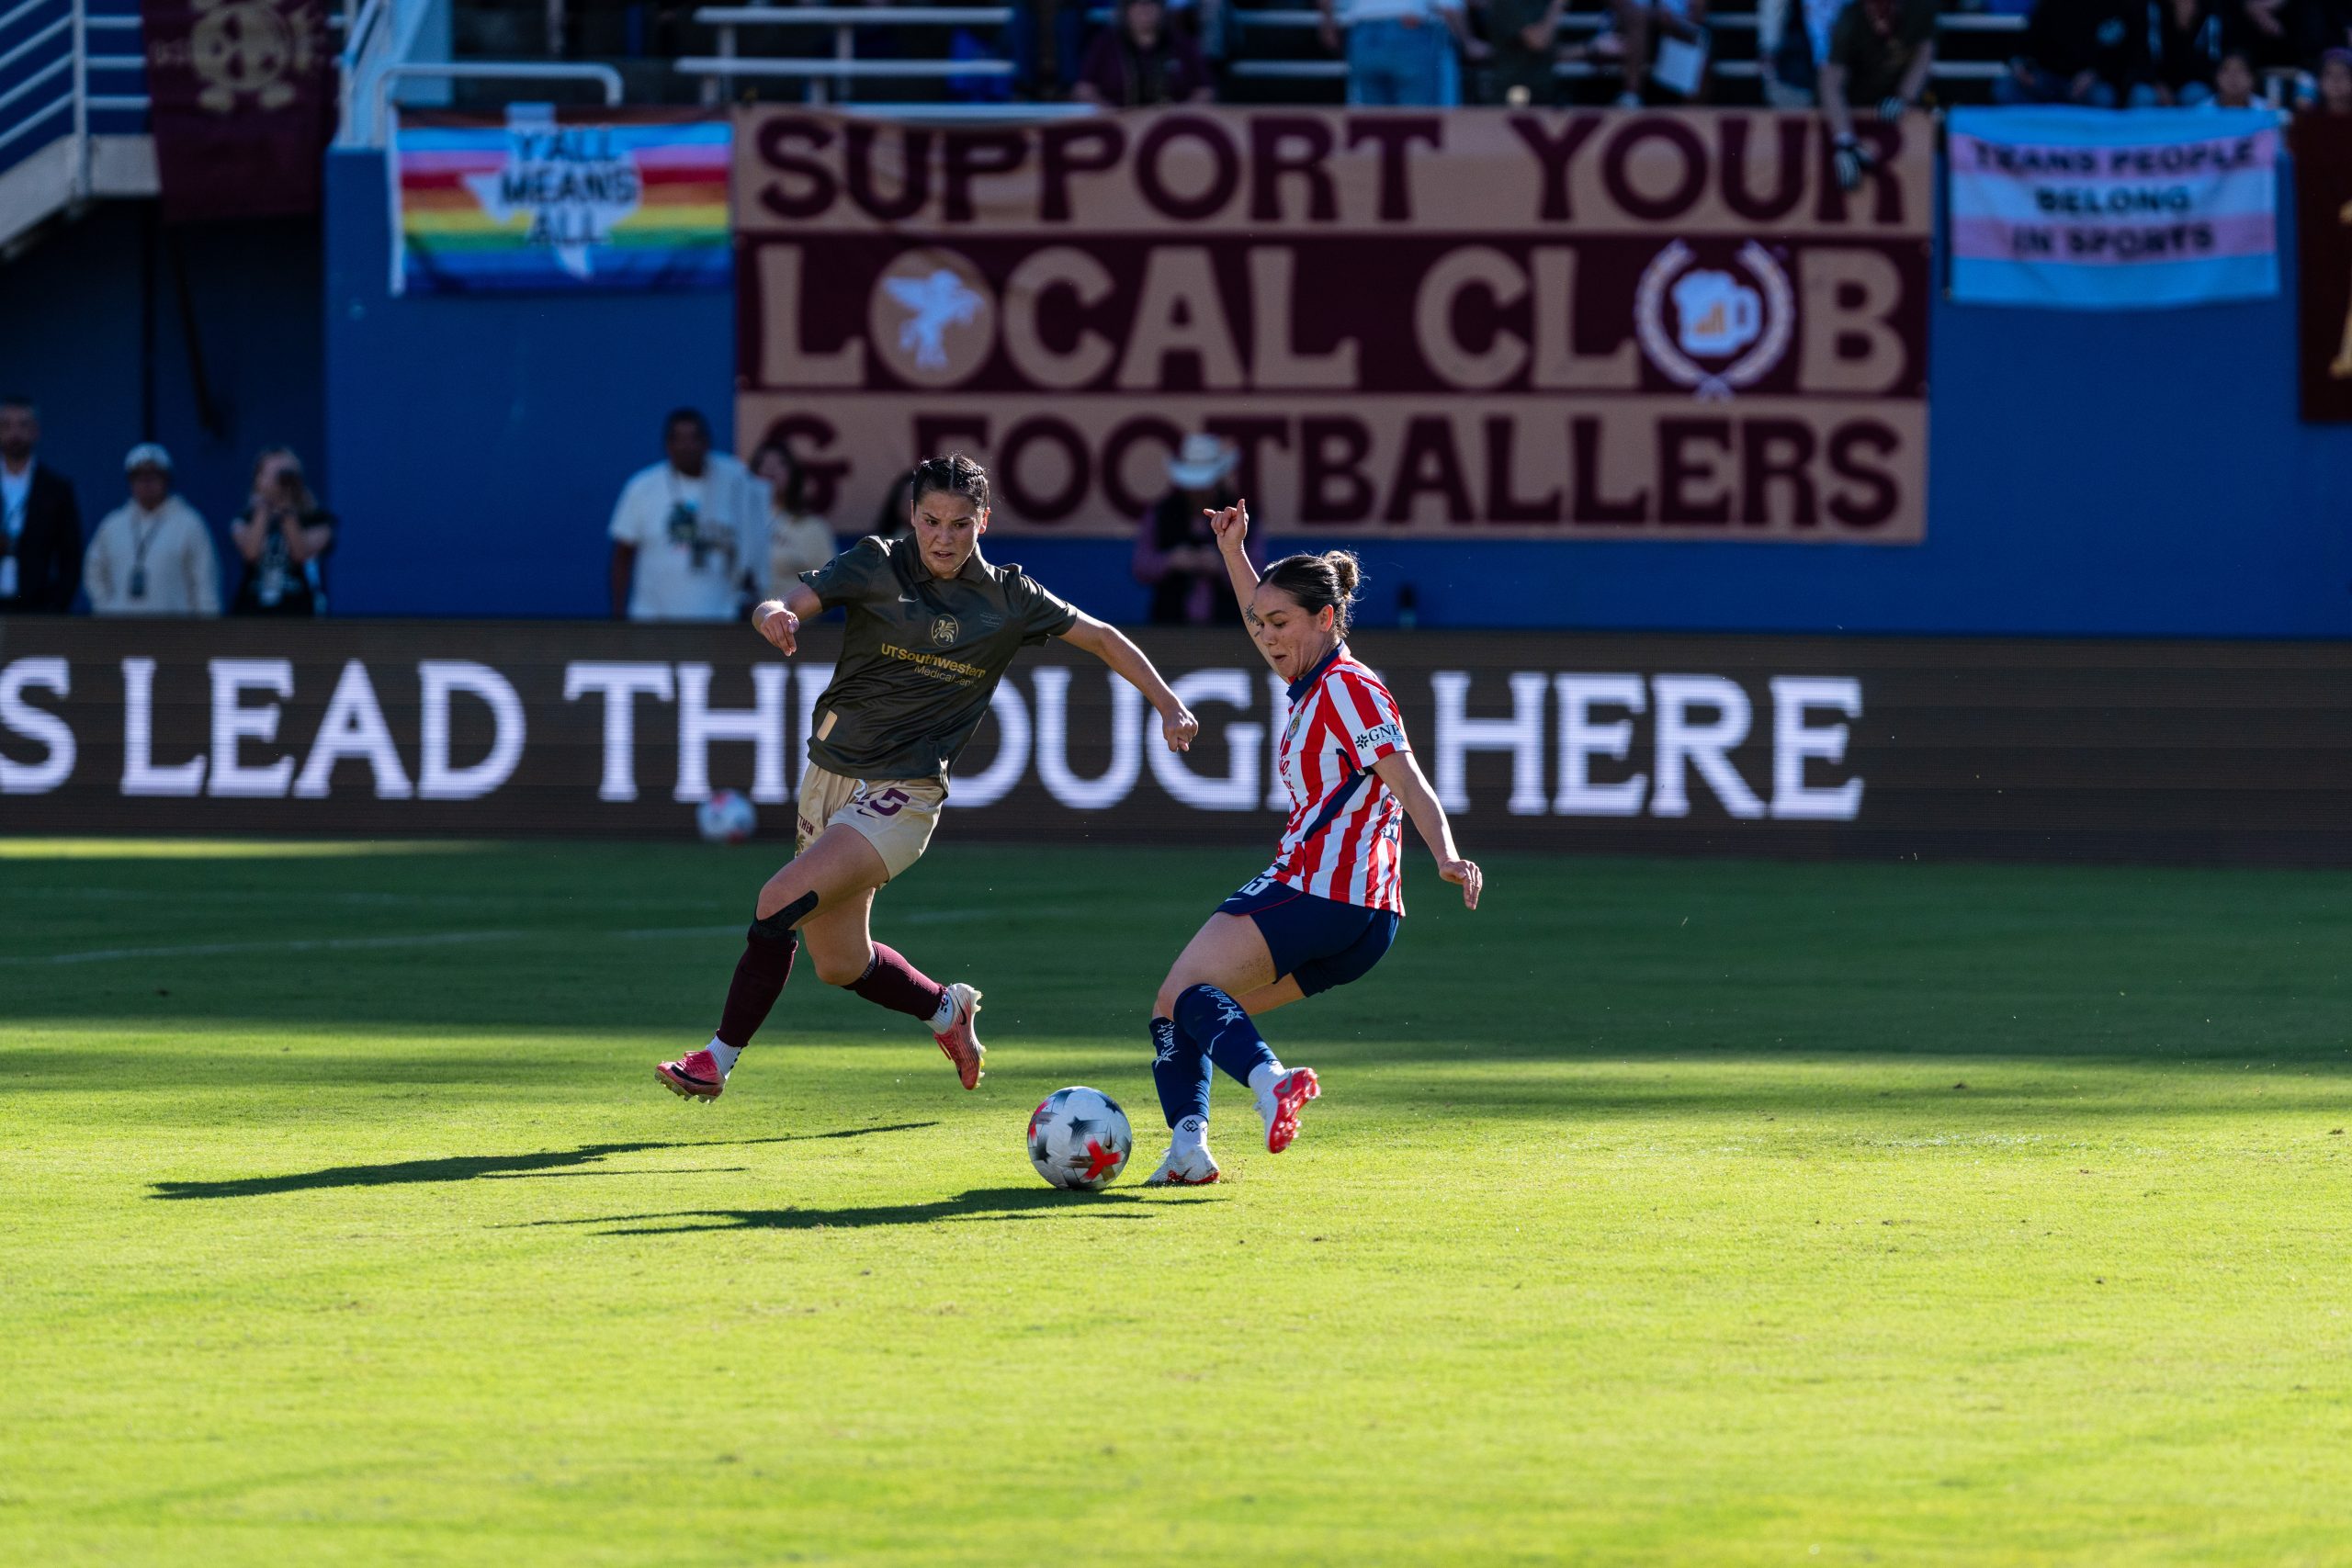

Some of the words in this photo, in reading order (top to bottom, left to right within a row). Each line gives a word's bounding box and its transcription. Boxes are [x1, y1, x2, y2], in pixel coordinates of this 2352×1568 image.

[514, 133, 621, 162] Y'ALL
[1972, 140, 2096, 174] TRANS
[2105, 139, 2255, 174] PEOPLE
[501, 165, 638, 203] MEANS
[756, 116, 1442, 222] SUPPORT
[1510, 115, 1905, 224] YOUR
[2034, 186, 2192, 215] BELONG
[526, 208, 613, 246] ALL
[2011, 227, 2052, 254] IN
[2069, 225, 2215, 257] SPORTS
[757, 244, 1360, 390] LOCAL
[913, 666, 956, 682] Medical
[120, 657, 527, 801] LEAD
[1430, 670, 1864, 821] HERE
[1369, 724, 1399, 742] GNP
